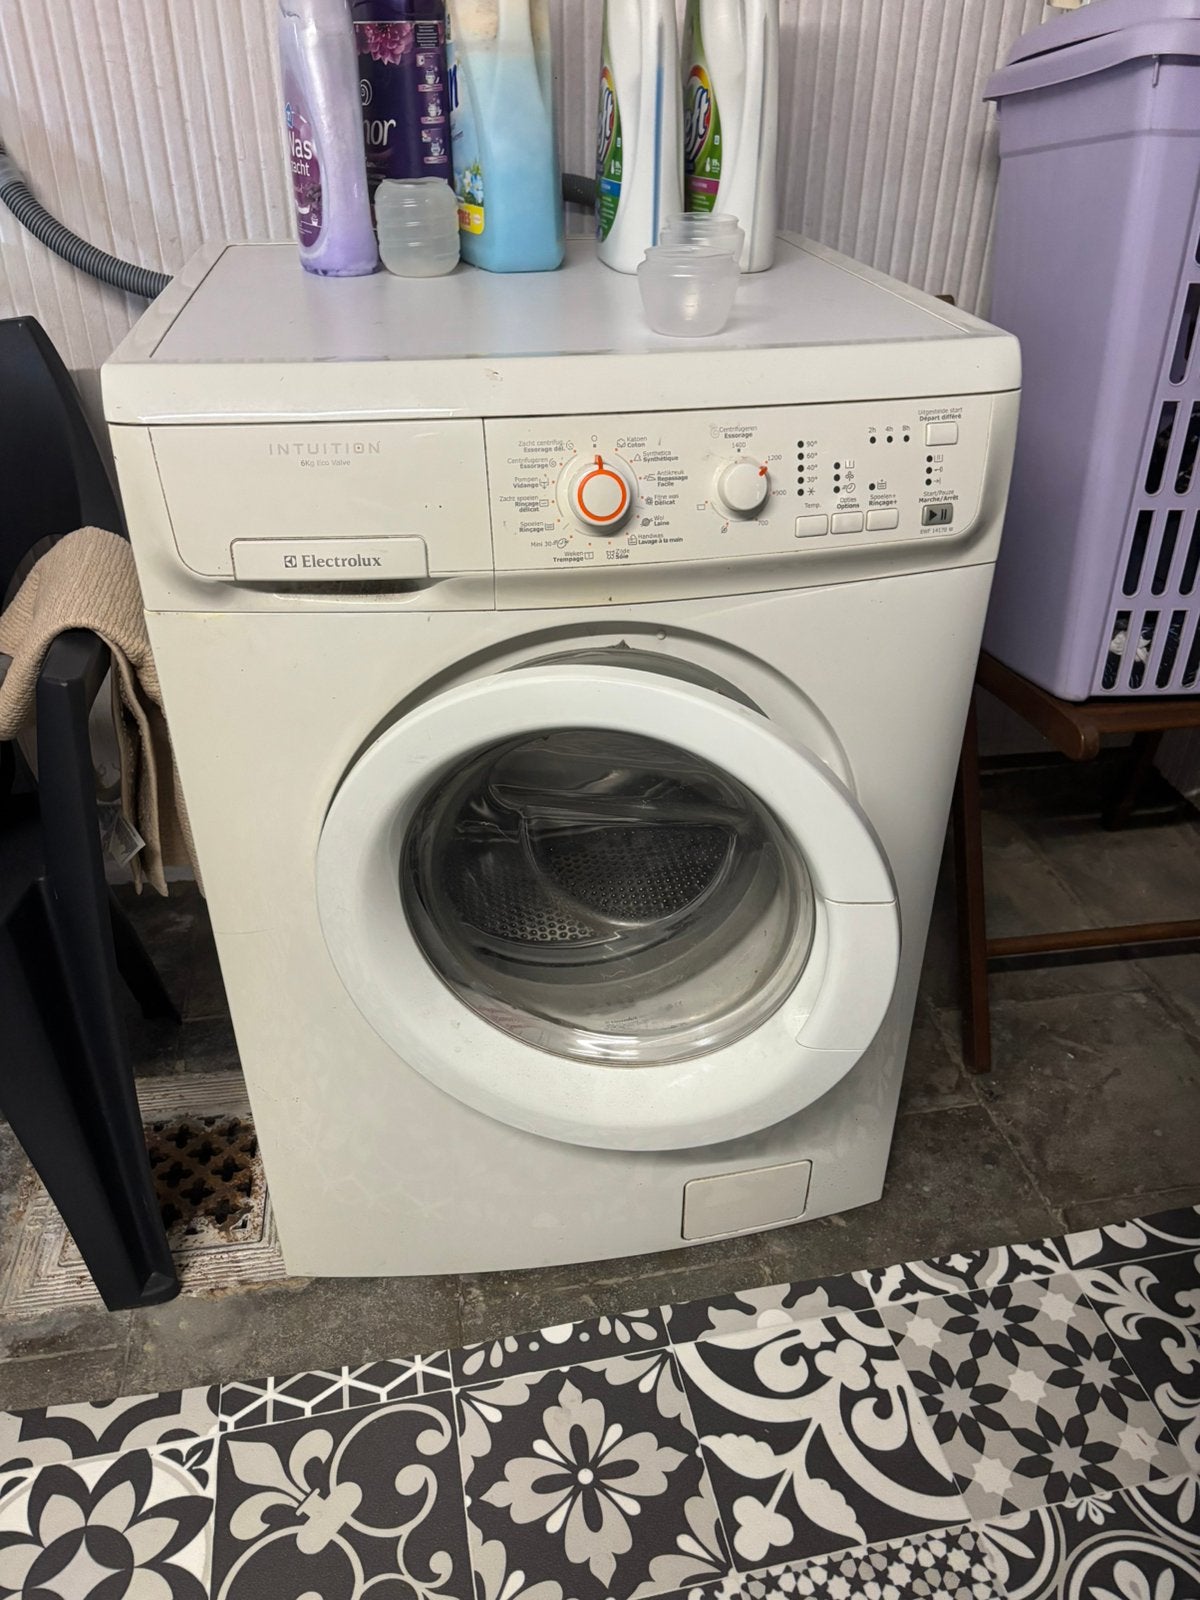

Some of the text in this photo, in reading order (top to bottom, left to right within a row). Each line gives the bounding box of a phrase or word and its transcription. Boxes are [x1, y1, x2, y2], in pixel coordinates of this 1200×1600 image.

[269, 442, 380, 455] INTUITION
[919, 495, 959, 503] Marche/Arrêt
[302, 554, 382, 568] Electrolux
